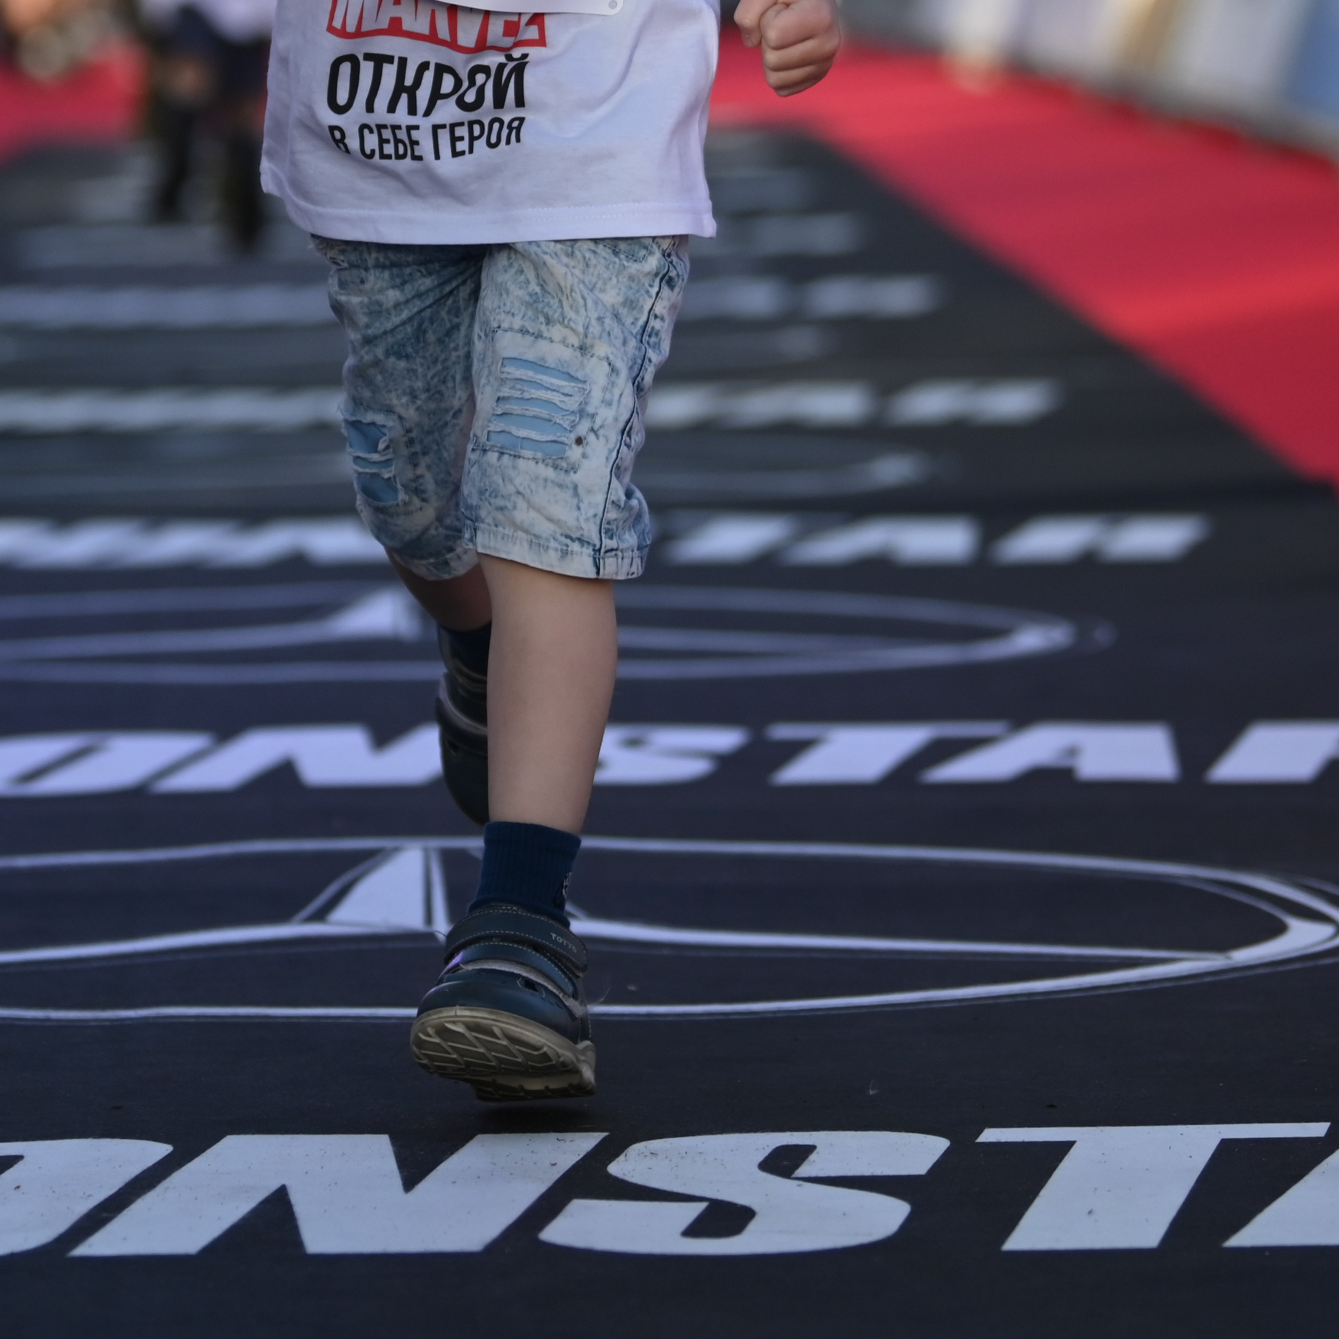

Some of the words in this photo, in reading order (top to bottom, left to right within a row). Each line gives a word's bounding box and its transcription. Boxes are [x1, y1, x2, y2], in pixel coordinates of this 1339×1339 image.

[327, 53, 529, 117] ОТКРОЙ
[328, 125, 351, 155] В
[358, 123, 424, 161] СЕБЕ
[432, 117, 526, 160] ГЕРОЯ
